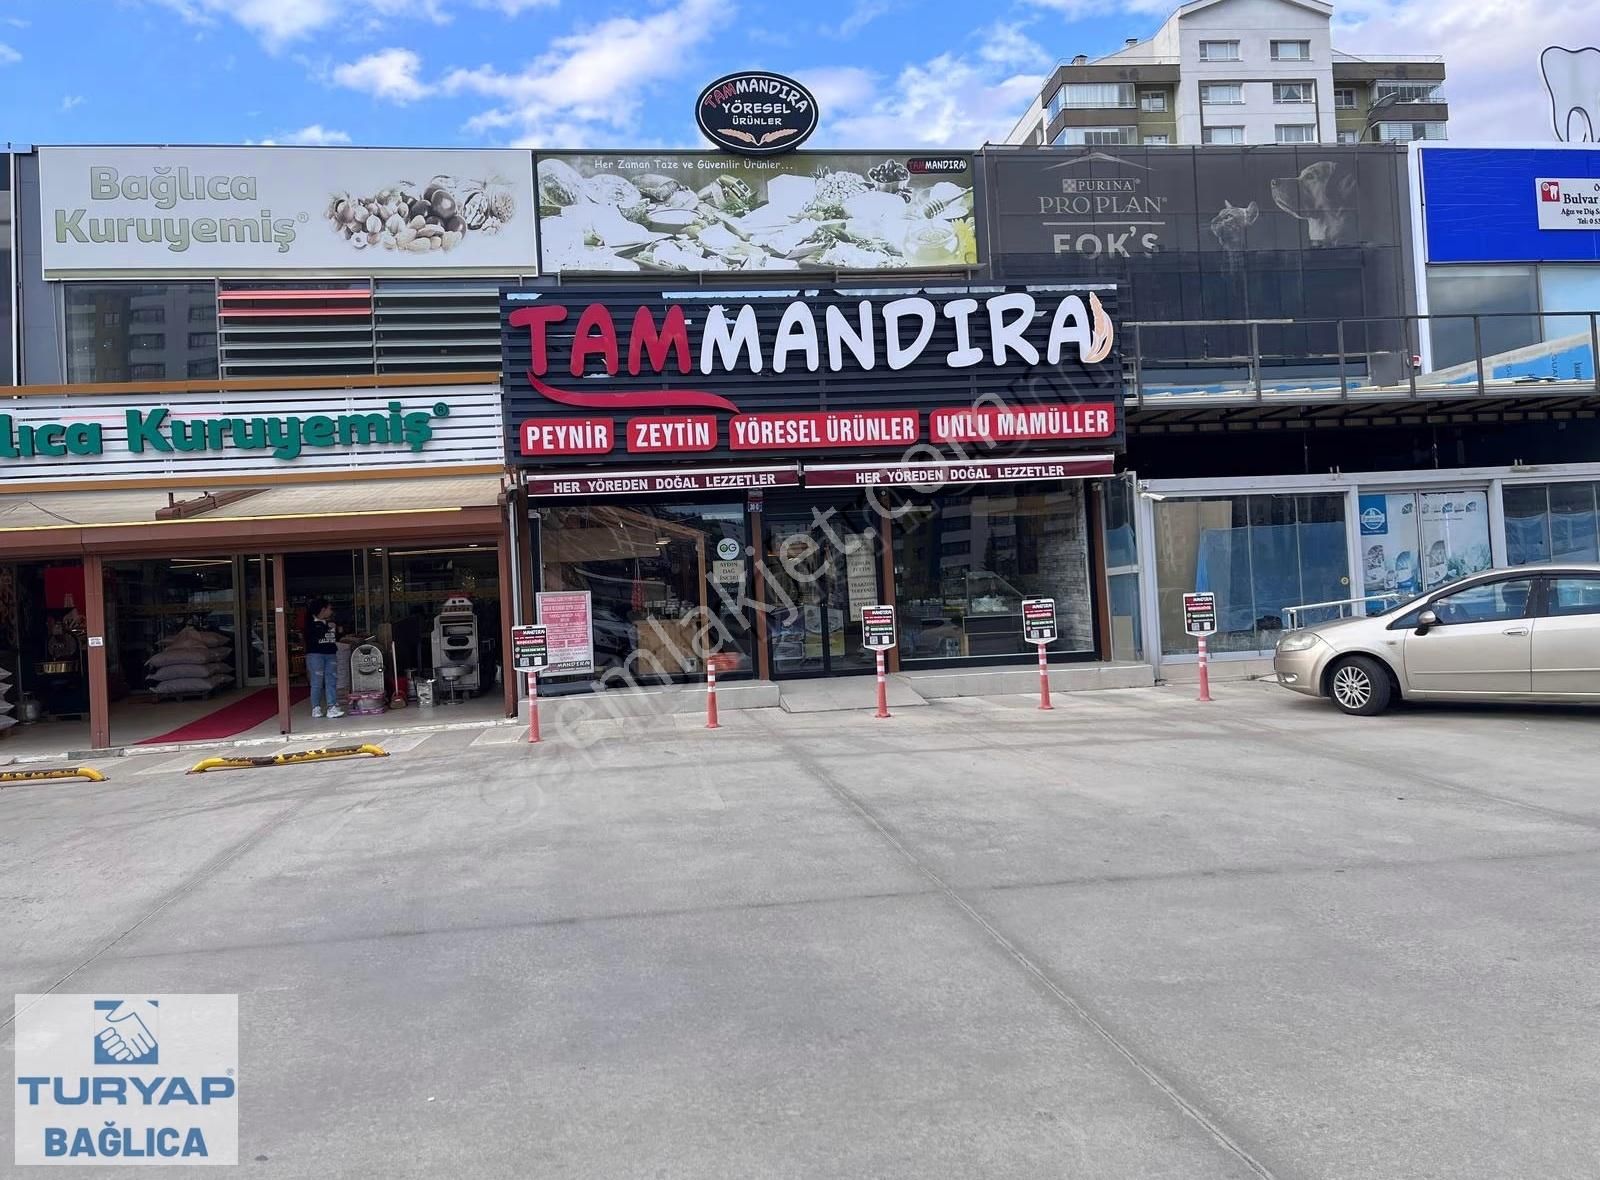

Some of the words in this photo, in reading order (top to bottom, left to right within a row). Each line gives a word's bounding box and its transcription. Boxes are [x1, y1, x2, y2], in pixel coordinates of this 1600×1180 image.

[704, 78, 809, 113] TAMMANDIRA
[722, 100, 791, 114] YÖRESEL
[732, 115, 782, 125] ÜRÜNLER
[594, 159, 613, 169] Her
[617, 159, 650, 169] Zaman
[654, 159, 679, 169] Taze
[683, 161, 694, 169] ve
[697, 159, 740, 169] Güvenilir
[90, 166, 257, 210] Bağlıca
[1078, 180, 1133, 191] PURINA
[1594, 183, 1600, 191] Ö
[1038, 196, 1090, 214] PRO
[1095, 196, 1161, 214] PLAN
[1563, 193, 1599, 204] Bulvar
[635, 418, 710, 447] ZEYTİN
[735, 417, 821, 444] YÖRESEL
[826, 414, 915, 442] ÜRÜNLER
[936, 411, 990, 438] UNLU
[998, 408, 1109, 436] MAMÜLLER
[526, 421, 608, 450] PEYNİR
[553, 481, 580, 494] HER
[588, 477, 648, 492] YÖREDEN
[656, 474, 699, 490] DOĞAL
[705, 473, 776, 488] LEZZETLER
[856, 472, 880, 484] HER
[887, 468, 943, 482] YÖREDEN
[951, 466, 991, 480] DOĞAL
[998, 464, 1065, 479] LEZZETLER
